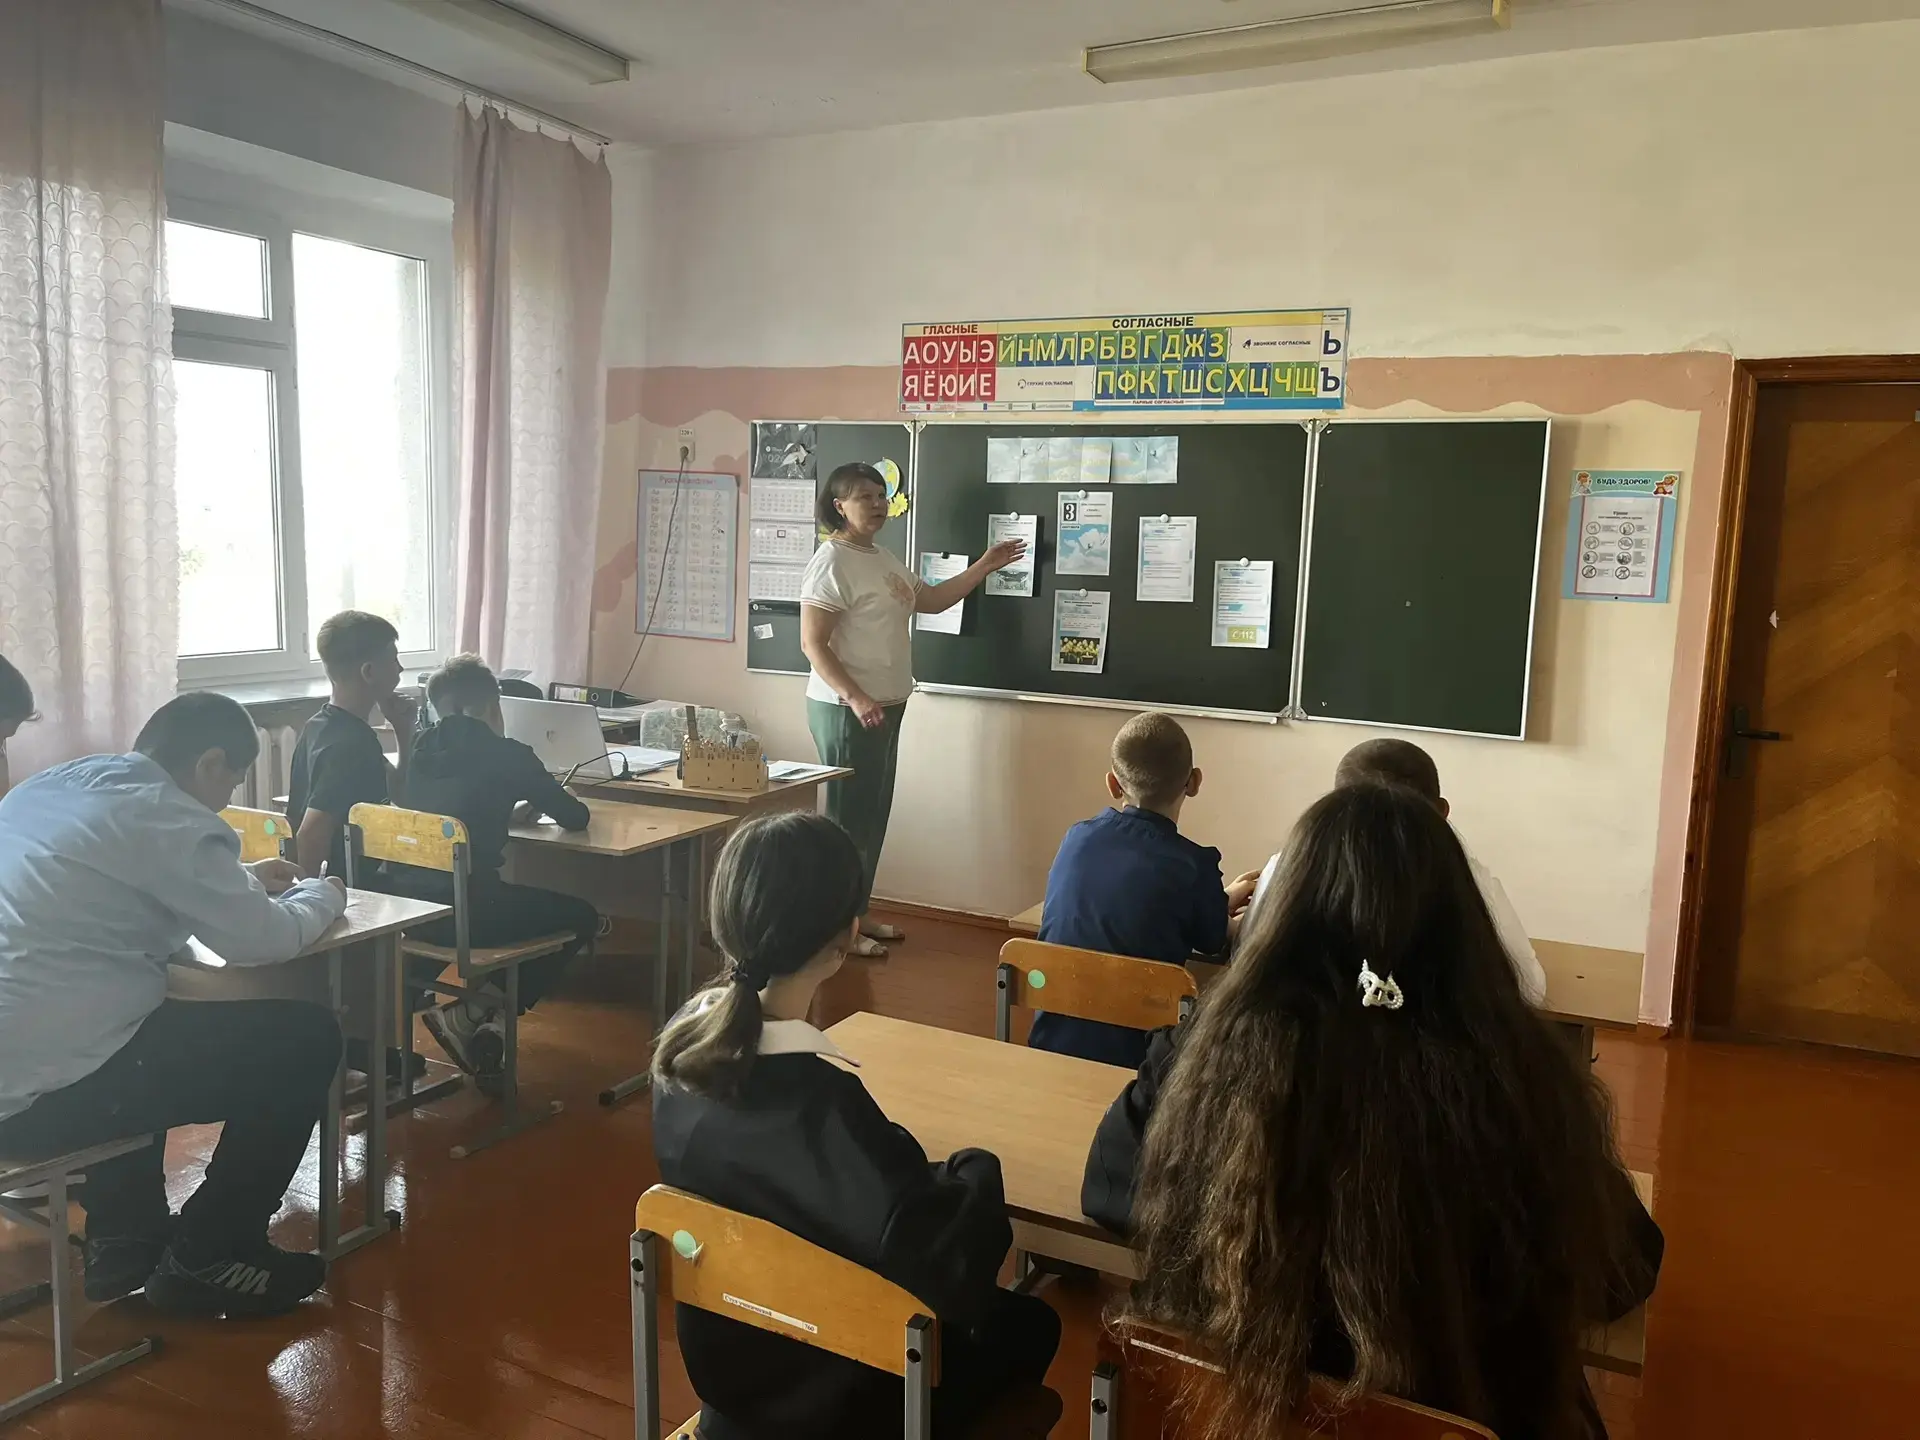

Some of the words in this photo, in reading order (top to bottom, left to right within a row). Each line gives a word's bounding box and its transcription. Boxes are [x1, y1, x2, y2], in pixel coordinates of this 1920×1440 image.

[1112, 316, 1194, 329] СОГЛАСНЫЕ
[923, 324, 978, 335] ГЛАСНЫЕ
[1596, 478, 1617, 486] БУДЬ
[1065, 503, 1075, 520] 3
[1241, 630, 1255, 640] 112
